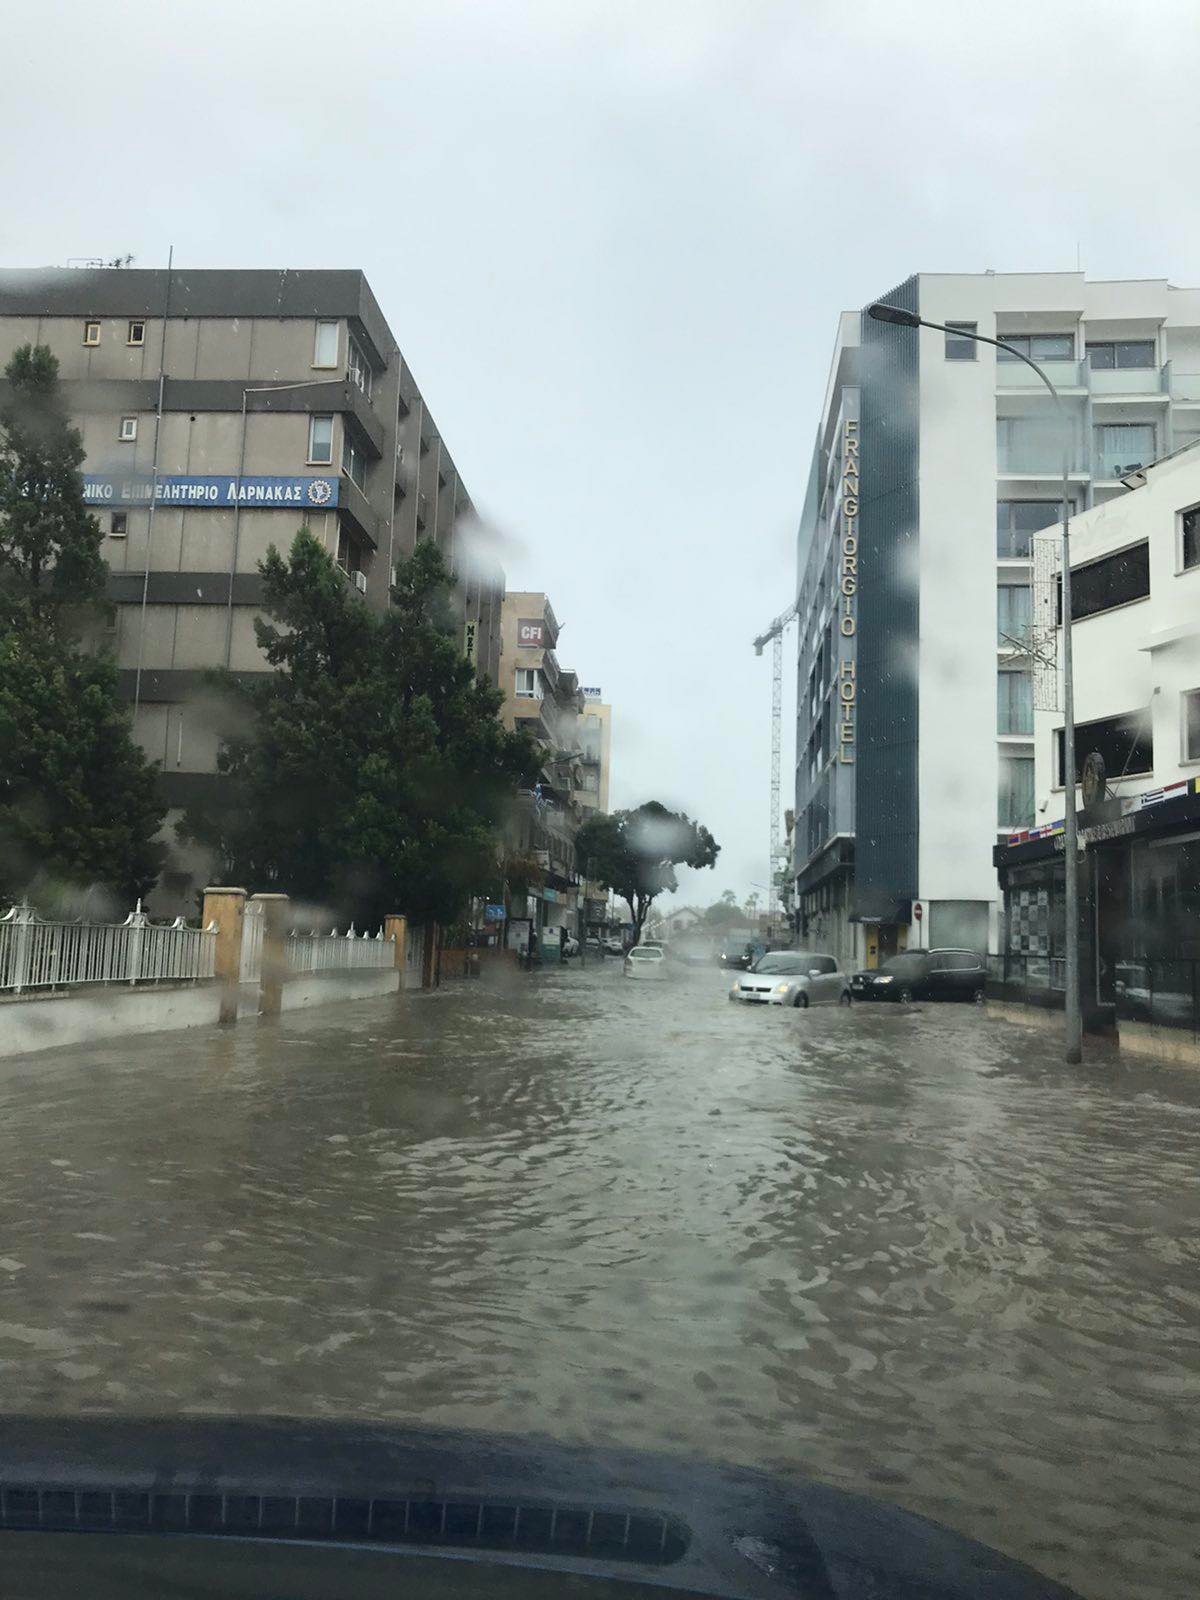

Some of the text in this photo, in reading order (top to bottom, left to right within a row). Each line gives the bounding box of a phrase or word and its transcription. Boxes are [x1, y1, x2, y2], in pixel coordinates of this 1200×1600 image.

[226, 482, 302, 500] ΛΑΡΝΑΚΑΣ
[840, 419, 859, 763] FRANGIORGIO HOTEL
[520, 625, 543, 640] CFI
